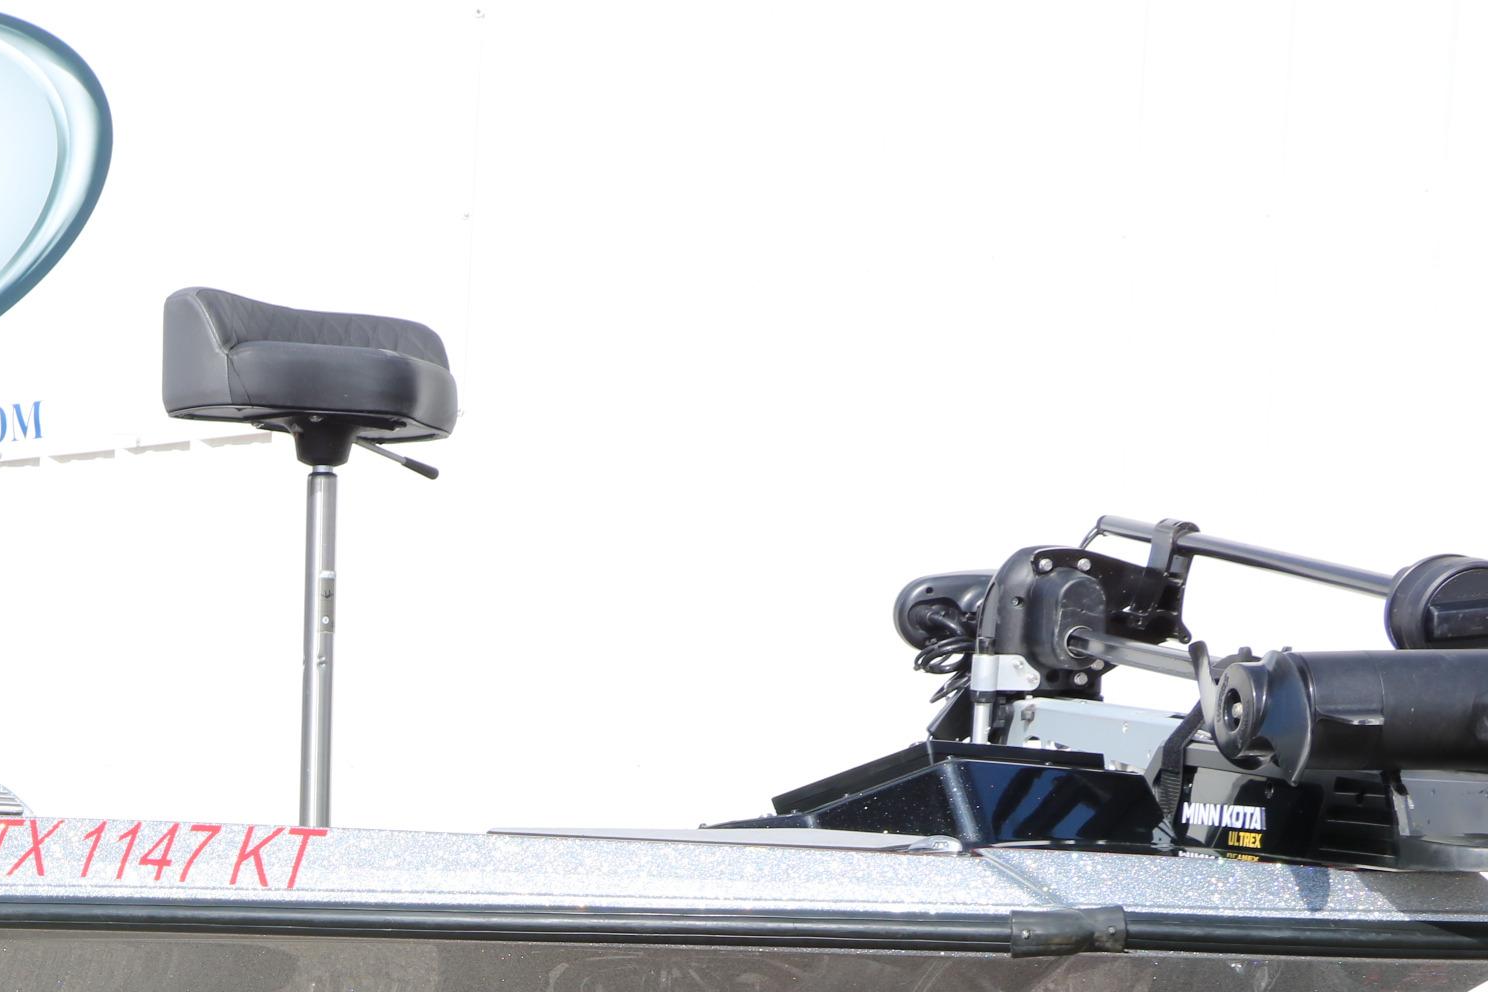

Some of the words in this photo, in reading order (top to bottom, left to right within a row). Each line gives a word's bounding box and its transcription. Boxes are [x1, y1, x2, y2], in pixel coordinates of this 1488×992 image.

[1181, 802, 1221, 827] MINN
[1221, 805, 1262, 830] KOTA
[1227, 831, 1263, 848] ULTREX
[80, 820, 222, 883] 1147
[229, 825, 329, 889] KT
